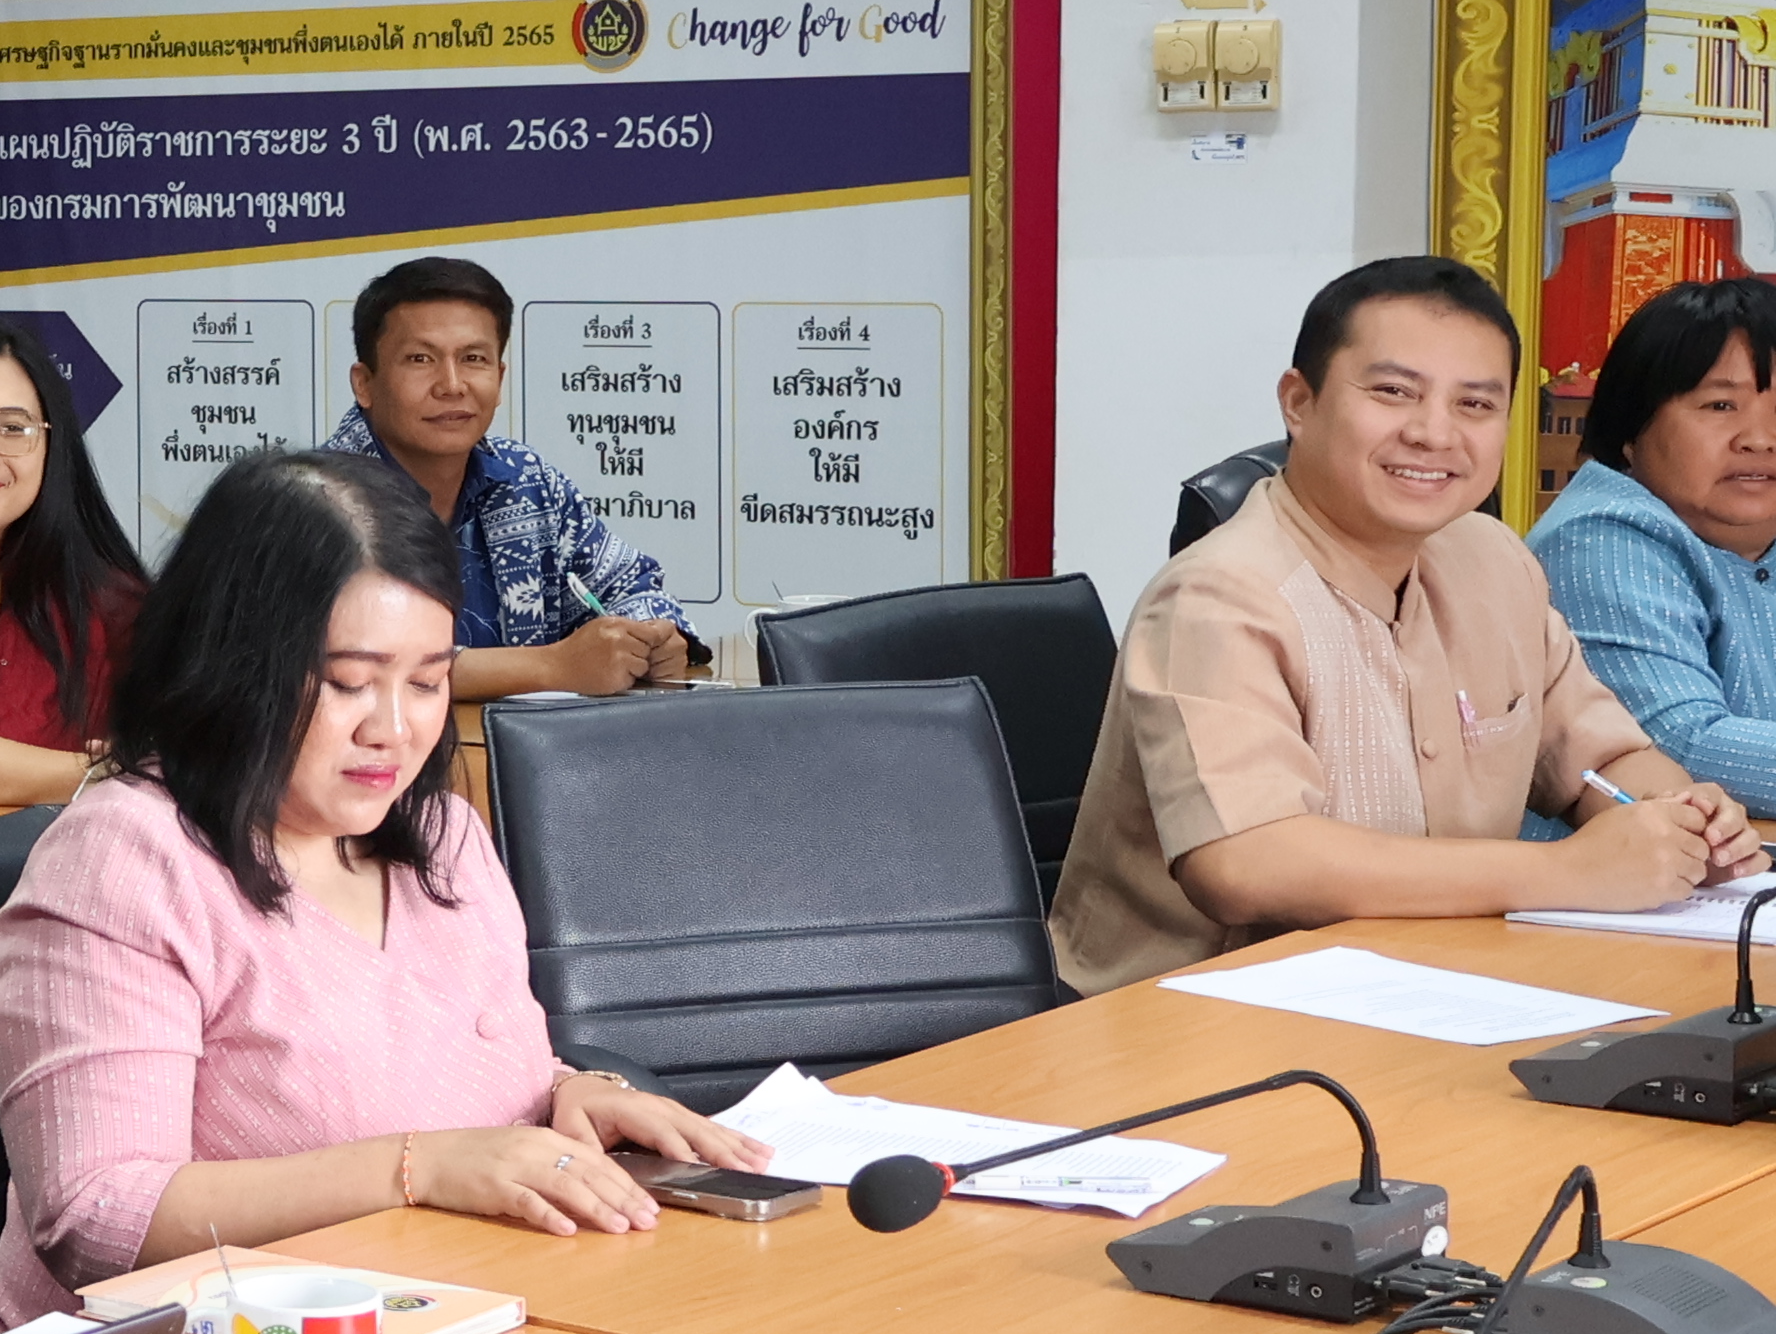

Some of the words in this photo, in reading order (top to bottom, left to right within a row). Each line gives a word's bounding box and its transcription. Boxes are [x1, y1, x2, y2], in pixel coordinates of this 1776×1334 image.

[412, 19, 494, 54] ภายในปี
[502, 22, 556, 48] 2565
[667, 7, 792, 57] Change
[798, 2, 851, 58] for
[342, 123, 362, 156] 3
[374, 114, 399, 157] ปี
[414, 113, 492, 160] (พ.ศ.
[192, 316, 238, 340] เรื่องที่
[582, 319, 637, 341] เรื่องที่
[640, 322, 653, 339] 3
[797, 320, 850, 344] เรื่องที่
[859, 325, 871, 341] 4
[166, 360, 281, 389] สร้างสรรค์
[560, 367, 682, 396] เสริมสร้าง
[771, 368, 903, 403] เสริมสร้าง
[191, 402, 257, 434] ชุมชน
[566, 410, 677, 440] ทุนชุมชน
[793, 410, 880, 445] องค์กร
[595, 442, 644, 477] ให้มี
[809, 447, 860, 490] ให้มี
[740, 495, 935, 541] ขีดสมรรถนะสูง
